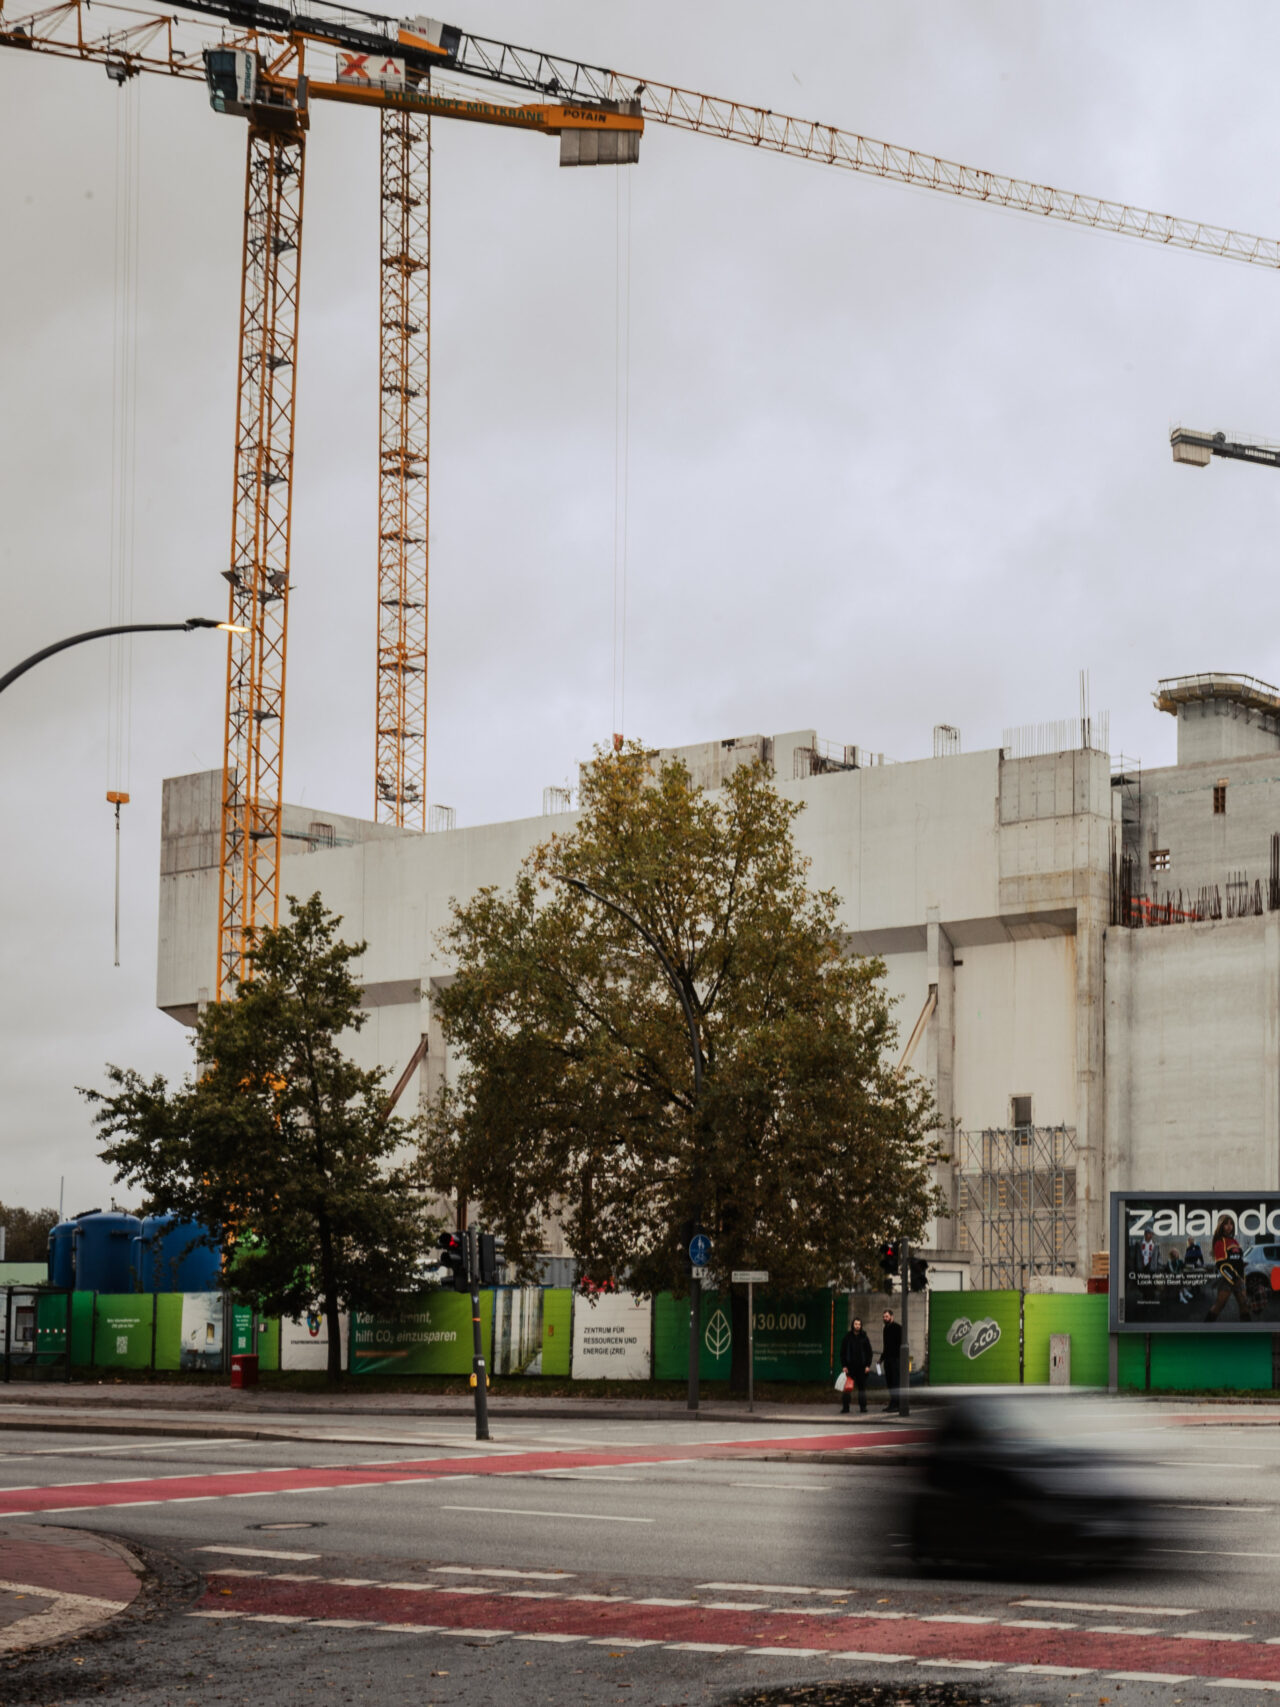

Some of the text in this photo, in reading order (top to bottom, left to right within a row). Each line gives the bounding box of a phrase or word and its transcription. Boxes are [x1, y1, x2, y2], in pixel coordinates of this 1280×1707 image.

[563, 107, 607, 123] POTAIN
[356, 1311, 374, 1324] Wer
[613, 1326, 625, 1334] FÜR
[356, 1330, 374, 1342] hilft
[396, 1330, 457, 1344] einzusparen
[624, 1336, 638, 1344] UND
[610, 1348, 626, 1356] (ZRE)
